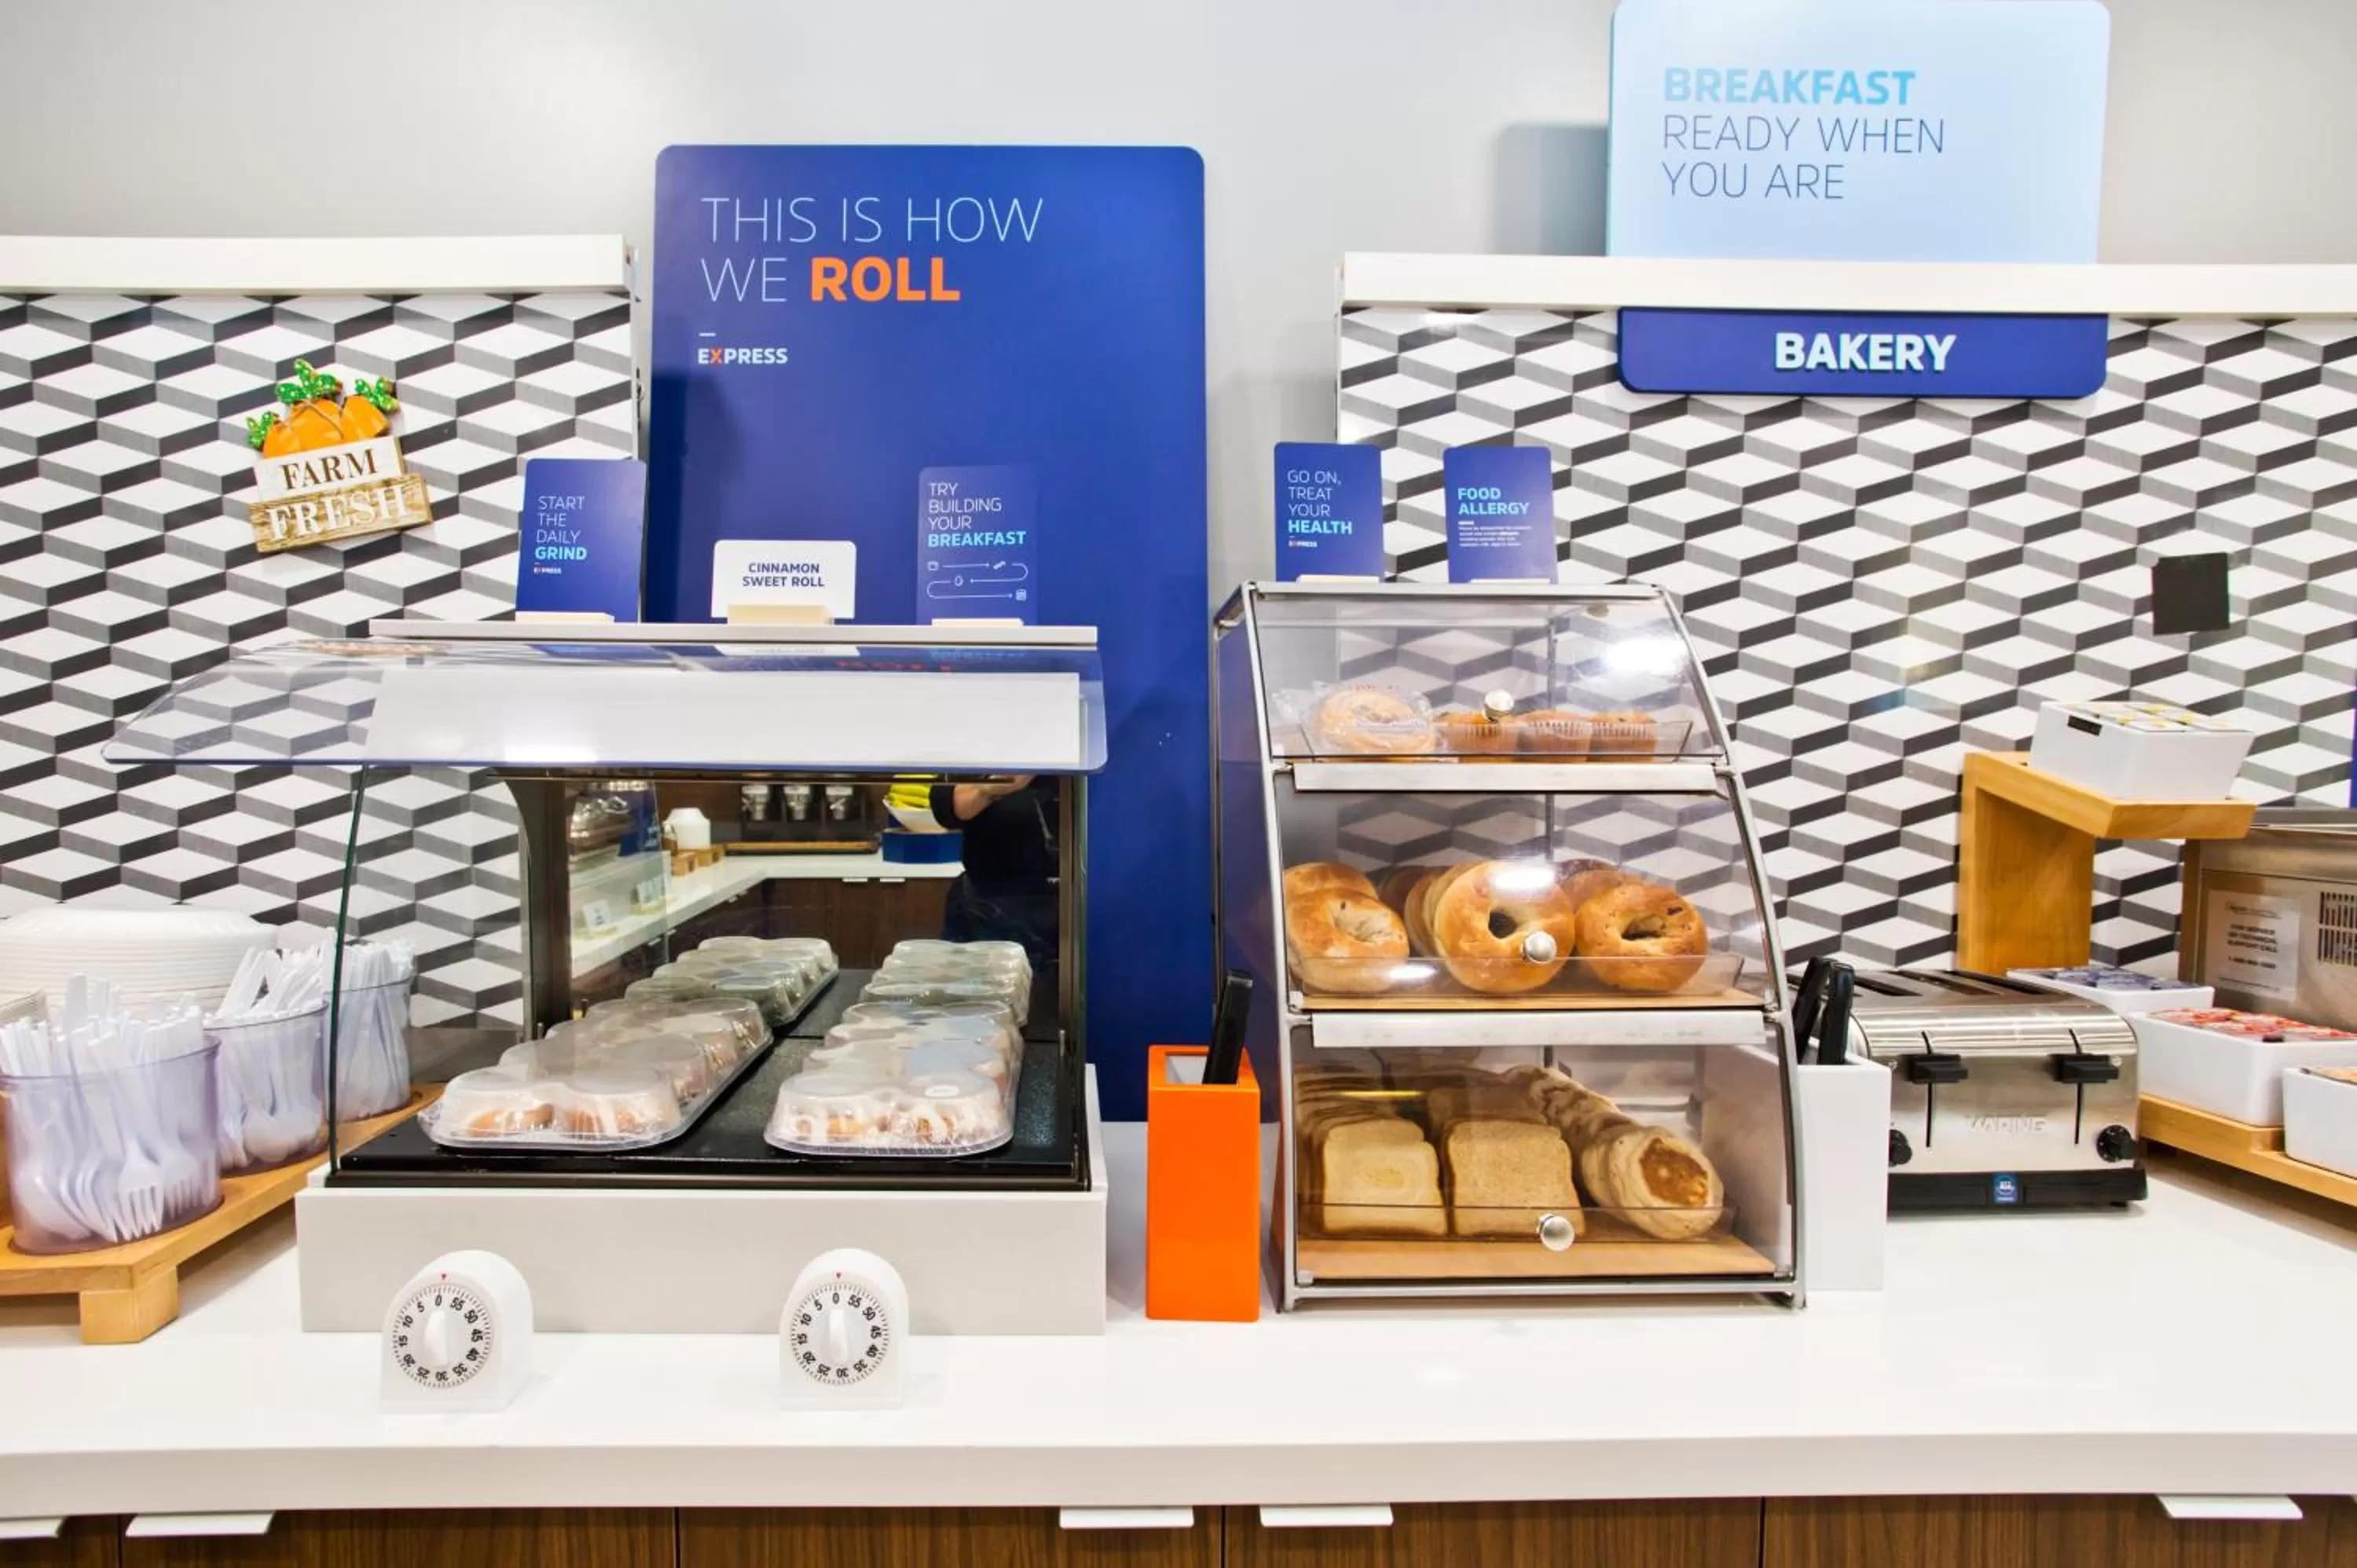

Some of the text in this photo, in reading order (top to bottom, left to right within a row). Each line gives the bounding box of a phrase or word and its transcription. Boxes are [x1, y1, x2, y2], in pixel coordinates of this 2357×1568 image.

[1663, 67, 1915, 104] BREAKFAST
[1662, 114, 1945, 154] READY WHEN
[1662, 161, 1845, 199] YOU ARE
[701, 196, 1043, 243] THIS IS HOW
[701, 255, 961, 302] WE ROLL
[698, 347, 789, 365] EXPRESS
[1774, 331, 1957, 372] BAKERY
[280, 448, 378, 491] FARM
[1288, 470, 1342, 485] GO ON,
[929, 482, 959, 496] TRY
[1288, 486, 1332, 500] TREAT
[1457, 487, 1501, 500] FOOD
[537, 496, 585, 510] START
[929, 497, 1002, 513] BUILDING
[1458, 502, 1530, 515] ALLERGY
[265, 485, 412, 540] FRESH
[1288, 504, 1330, 517] YOUR
[537, 512, 566, 527] THE
[928, 515, 972, 530] YOUR
[1288, 519, 1353, 534] HEALTH
[536, 529, 581, 544] DAILY
[928, 530, 1027, 548] BREAKFAST
[535, 546, 588, 560] GRIND
[748, 562, 820, 574] CINNAMON
[742, 575, 824, 588] SWEET ROLL
[435, 1295, 442, 1306] 0
[450, 1297, 465, 1311] 55
[814, 1299, 823, 1311] 5
[833, 1292, 839, 1304] 0
[849, 1295, 862, 1308] 55
[417, 1302, 424, 1313] 5
[863, 1306, 875, 1321] 50
[402, 1315, 413, 1328] 10
[464, 1310, 478, 1324] 50
[801, 1313, 812, 1326] 10
[471, 1328, 483, 1343] 45
[797, 1333, 808, 1345] 15
[871, 1325, 882, 1339] 45
[398, 1335, 408, 1346] 15
[466, 1347, 479, 1361] 40
[803, 1351, 816, 1364] 20
[867, 1344, 878, 1357] 40
[403, 1354, 416, 1367] 20
[854, 1359, 867, 1373] 35
[416, 1367, 430, 1379] 25
[435, 1371, 449, 1382] 30
[453, 1364, 467, 1376] 35
[817, 1364, 830, 1376] 25
[836, 1368, 849, 1378] 30
